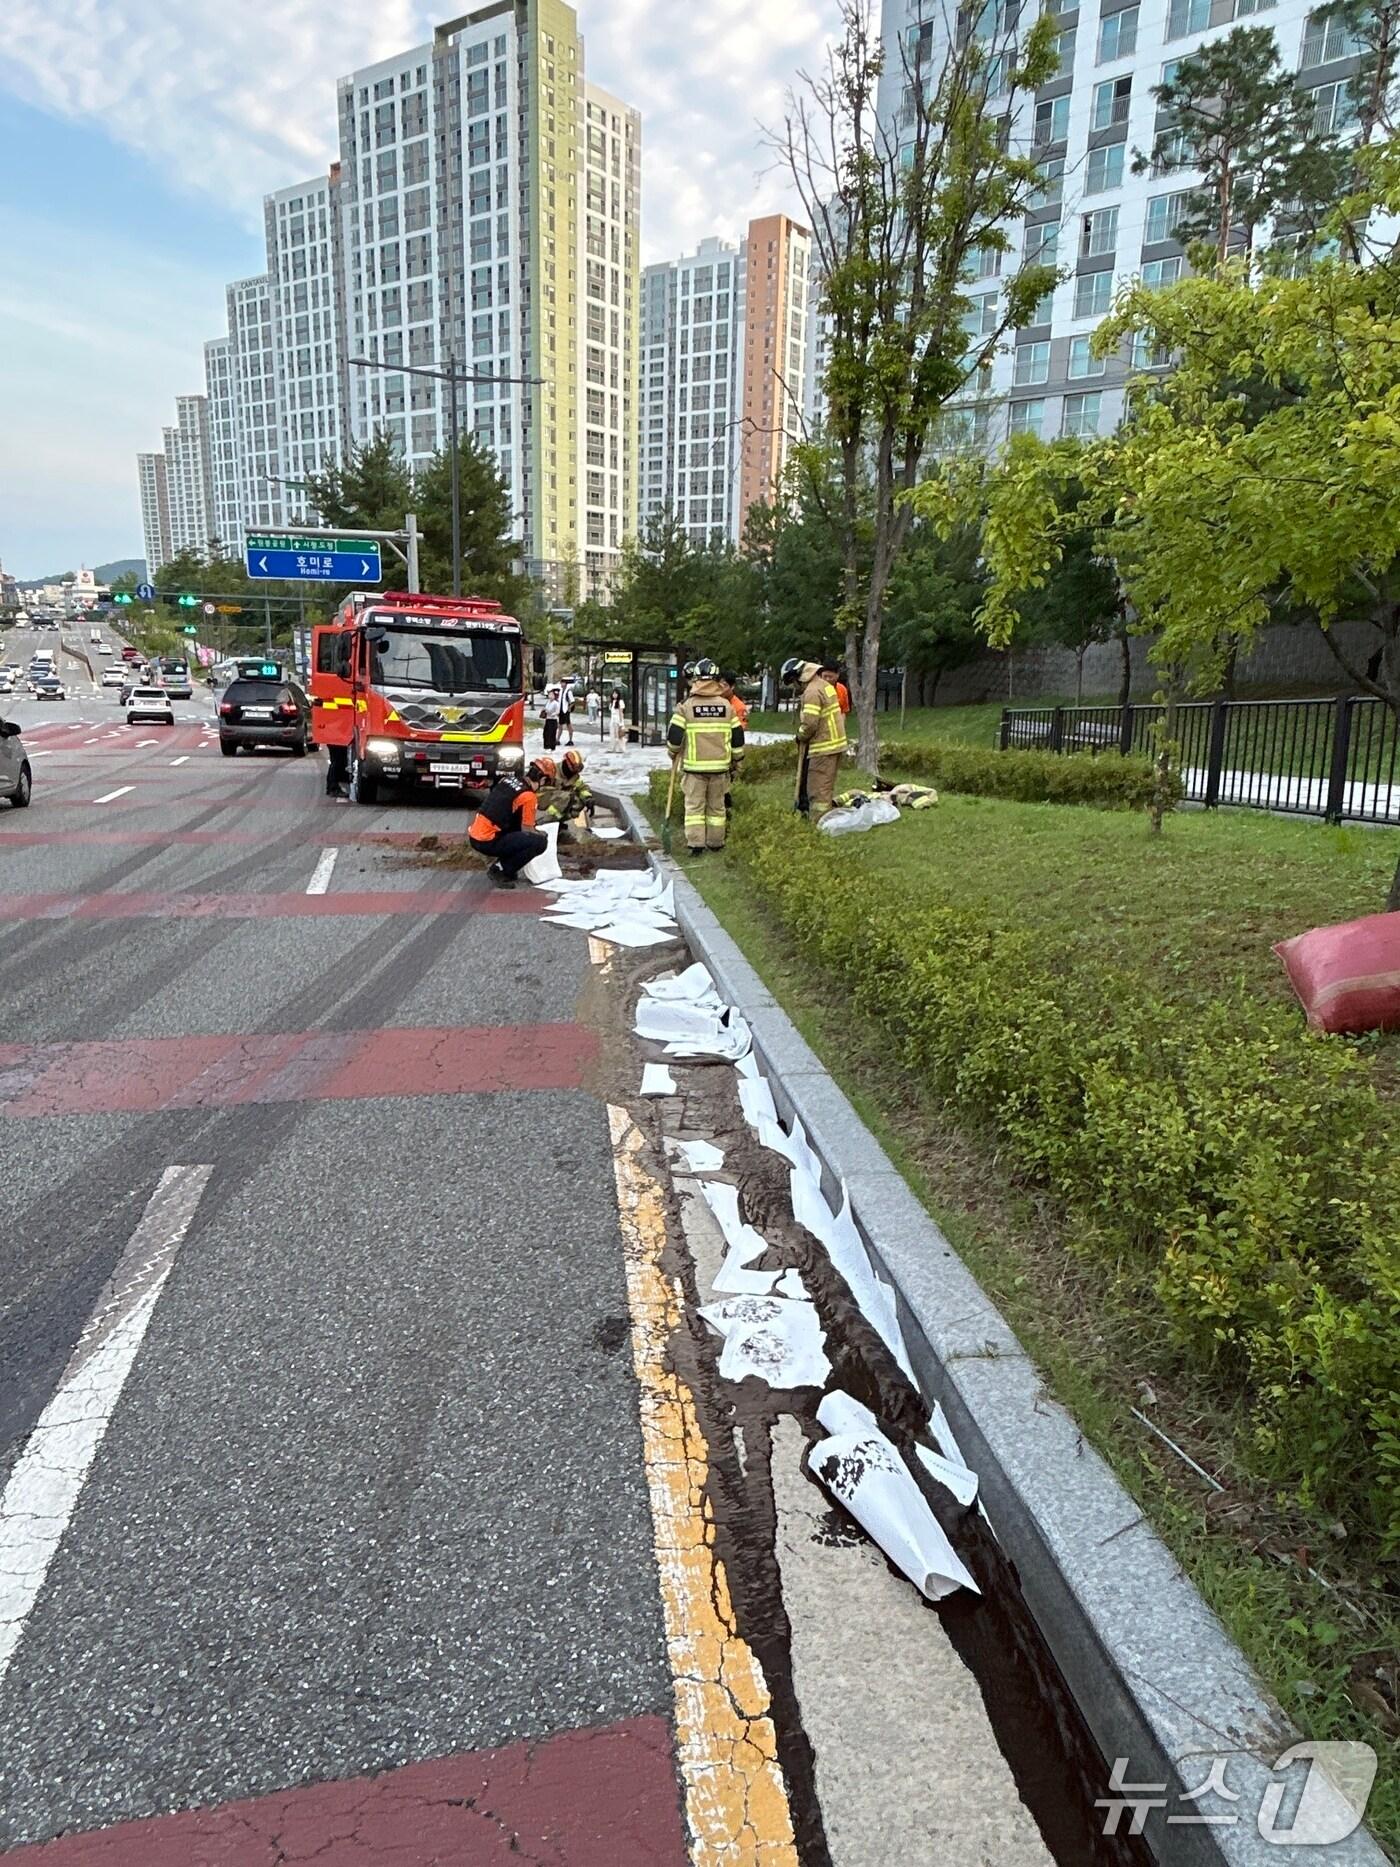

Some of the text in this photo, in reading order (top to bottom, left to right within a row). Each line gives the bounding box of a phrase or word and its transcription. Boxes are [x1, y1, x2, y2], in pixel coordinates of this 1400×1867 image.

[557, 40, 567, 137] CANTAVIL
[296, 556, 333, 569] 호미로
[300, 568, 330, 576] Homi-ro
